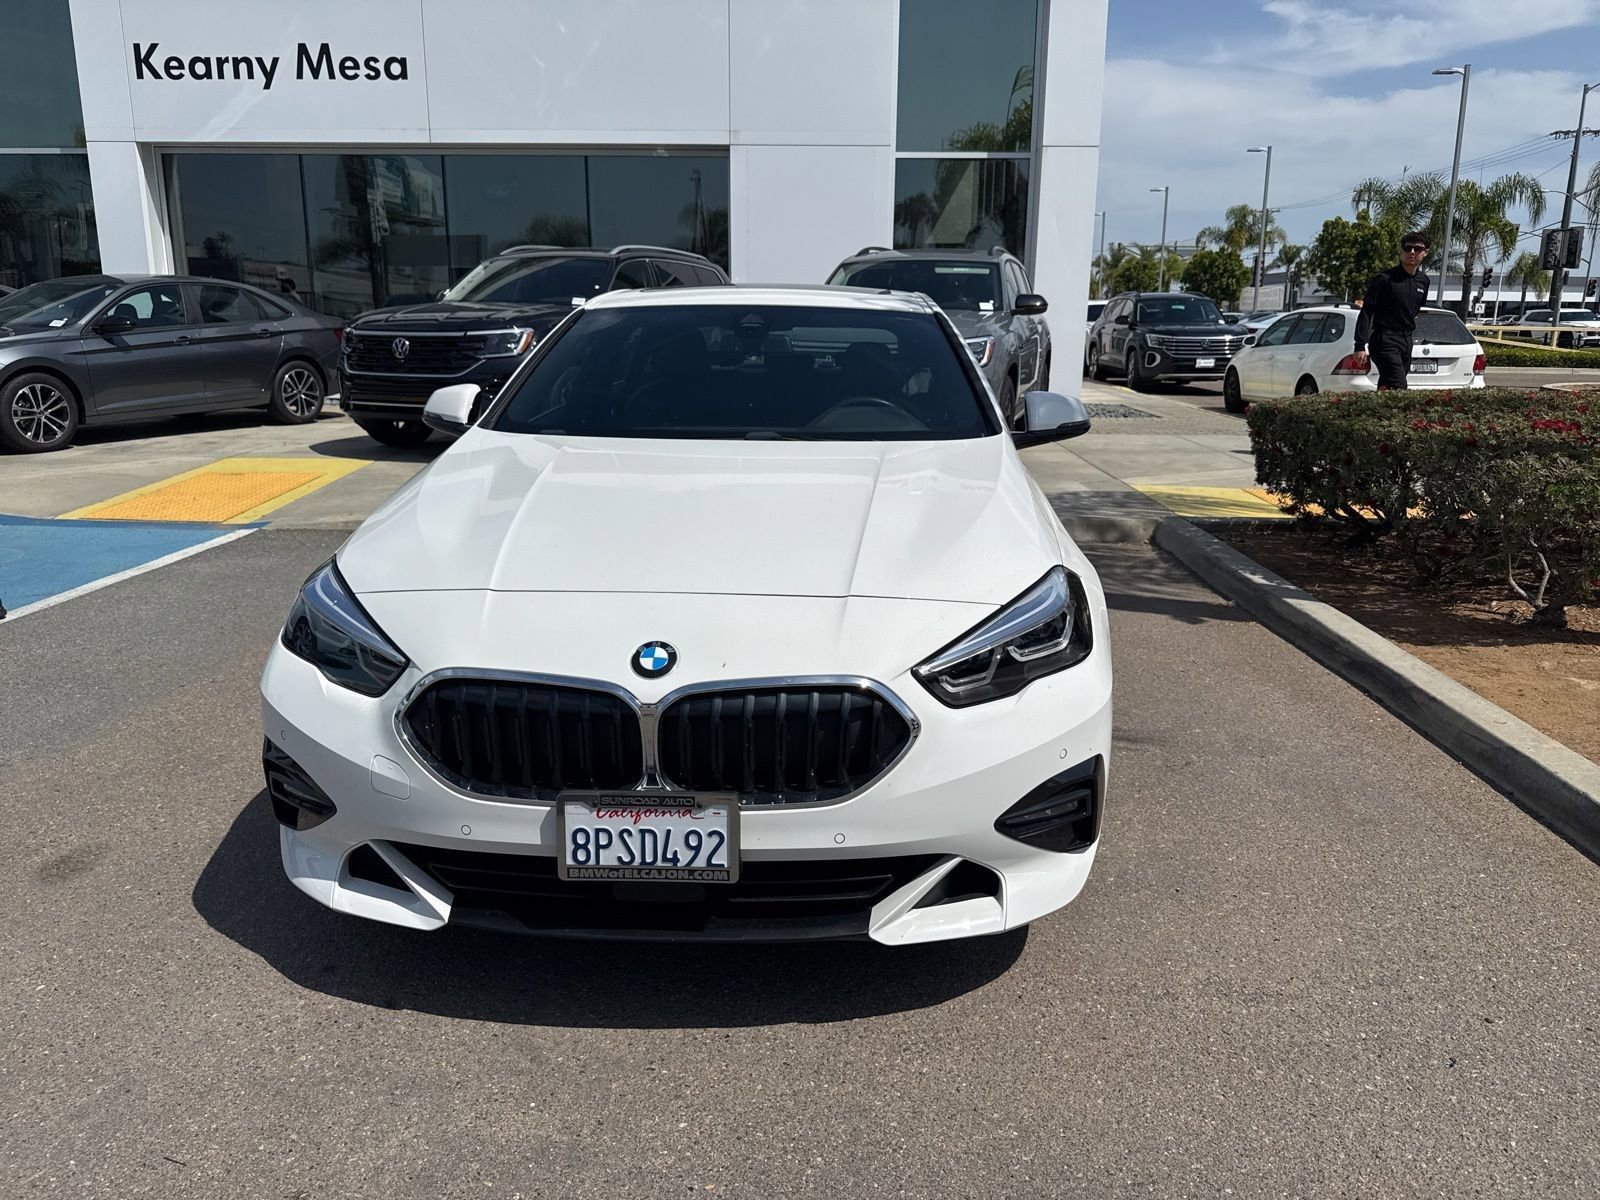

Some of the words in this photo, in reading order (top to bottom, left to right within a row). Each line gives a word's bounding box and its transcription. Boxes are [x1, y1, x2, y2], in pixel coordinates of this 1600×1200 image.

[132, 42, 280, 90] Kearny
[296, 42, 409, 81] Mesa
[600, 797, 657, 805] SUNROAD
[662, 797, 694, 806] AUTO
[572, 827, 726, 867] 8PSD492
[568, 868, 728, 881] BMWofELCAJON.COM
